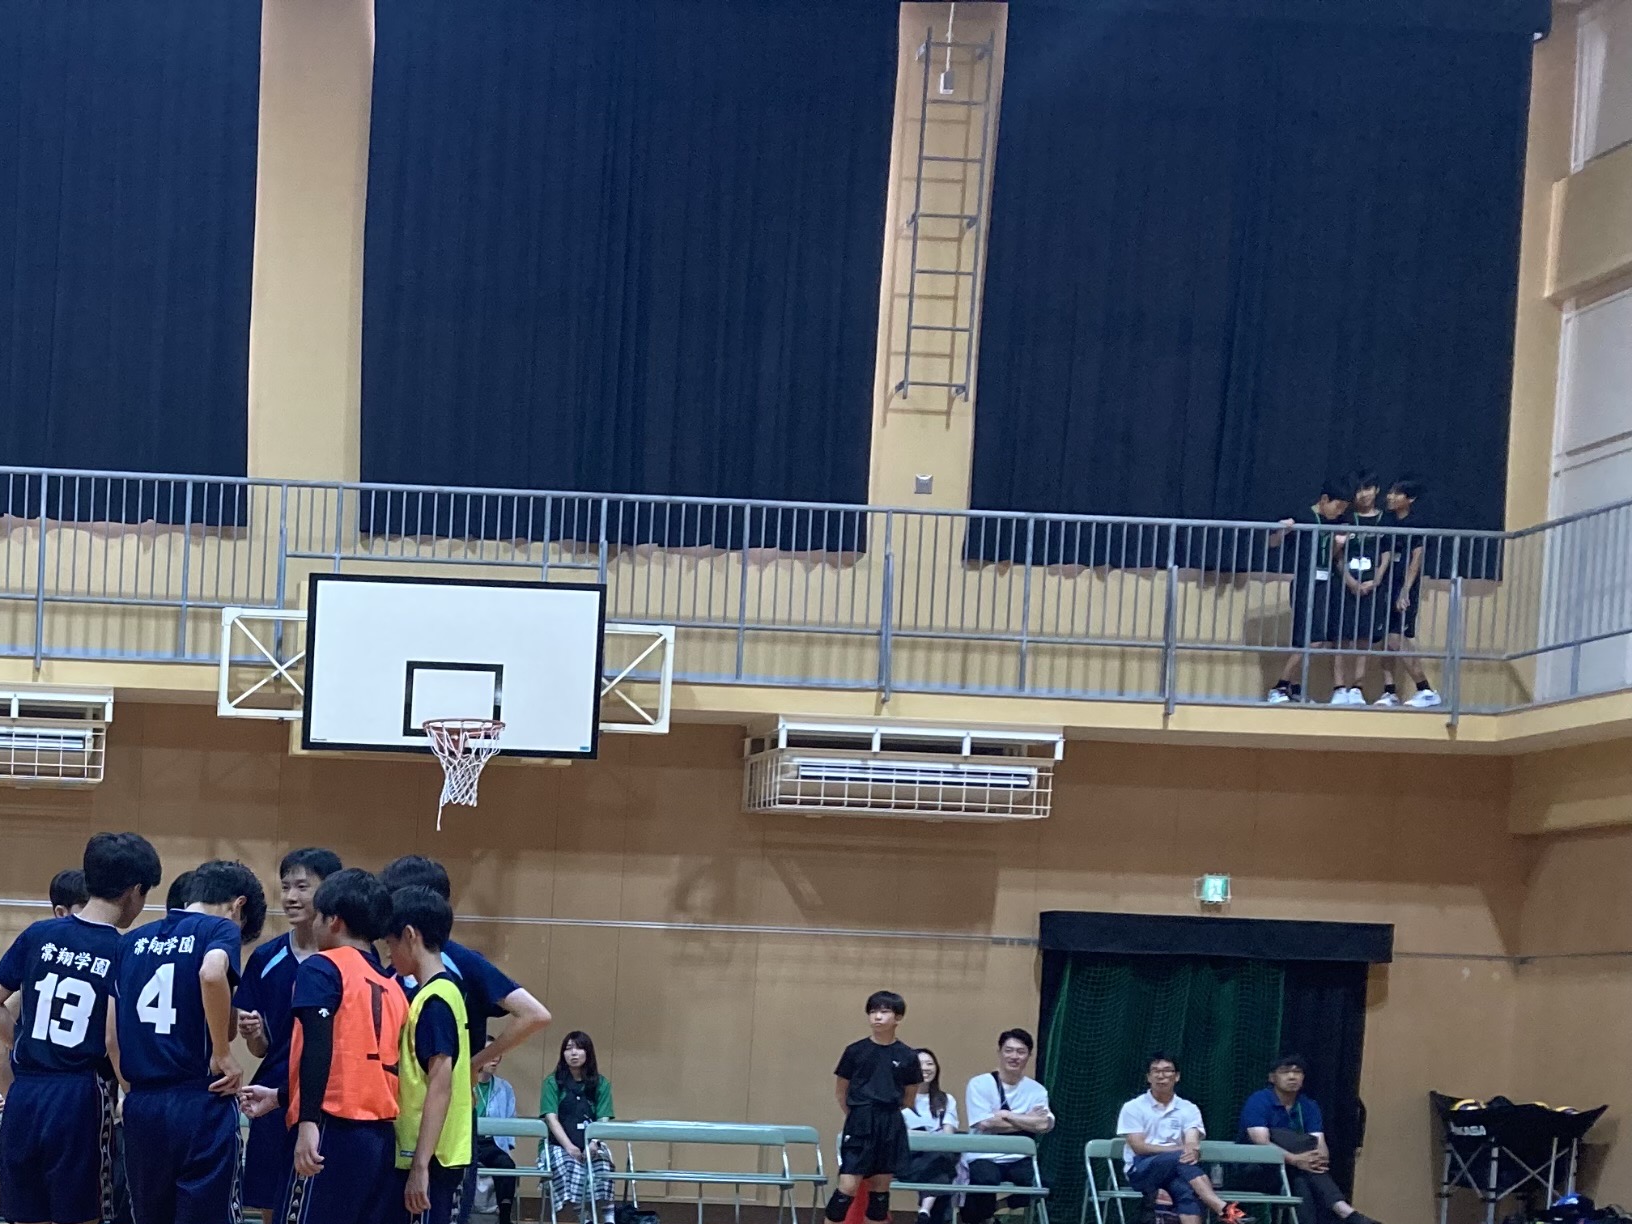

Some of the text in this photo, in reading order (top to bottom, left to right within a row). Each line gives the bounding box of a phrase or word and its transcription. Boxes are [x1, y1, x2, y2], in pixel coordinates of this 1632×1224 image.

[41, 942, 110, 978] 常翔学園
[134, 935, 195, 955] 常翔学園
[31, 972, 96, 1048] 13
[136, 963, 177, 1034] 4
